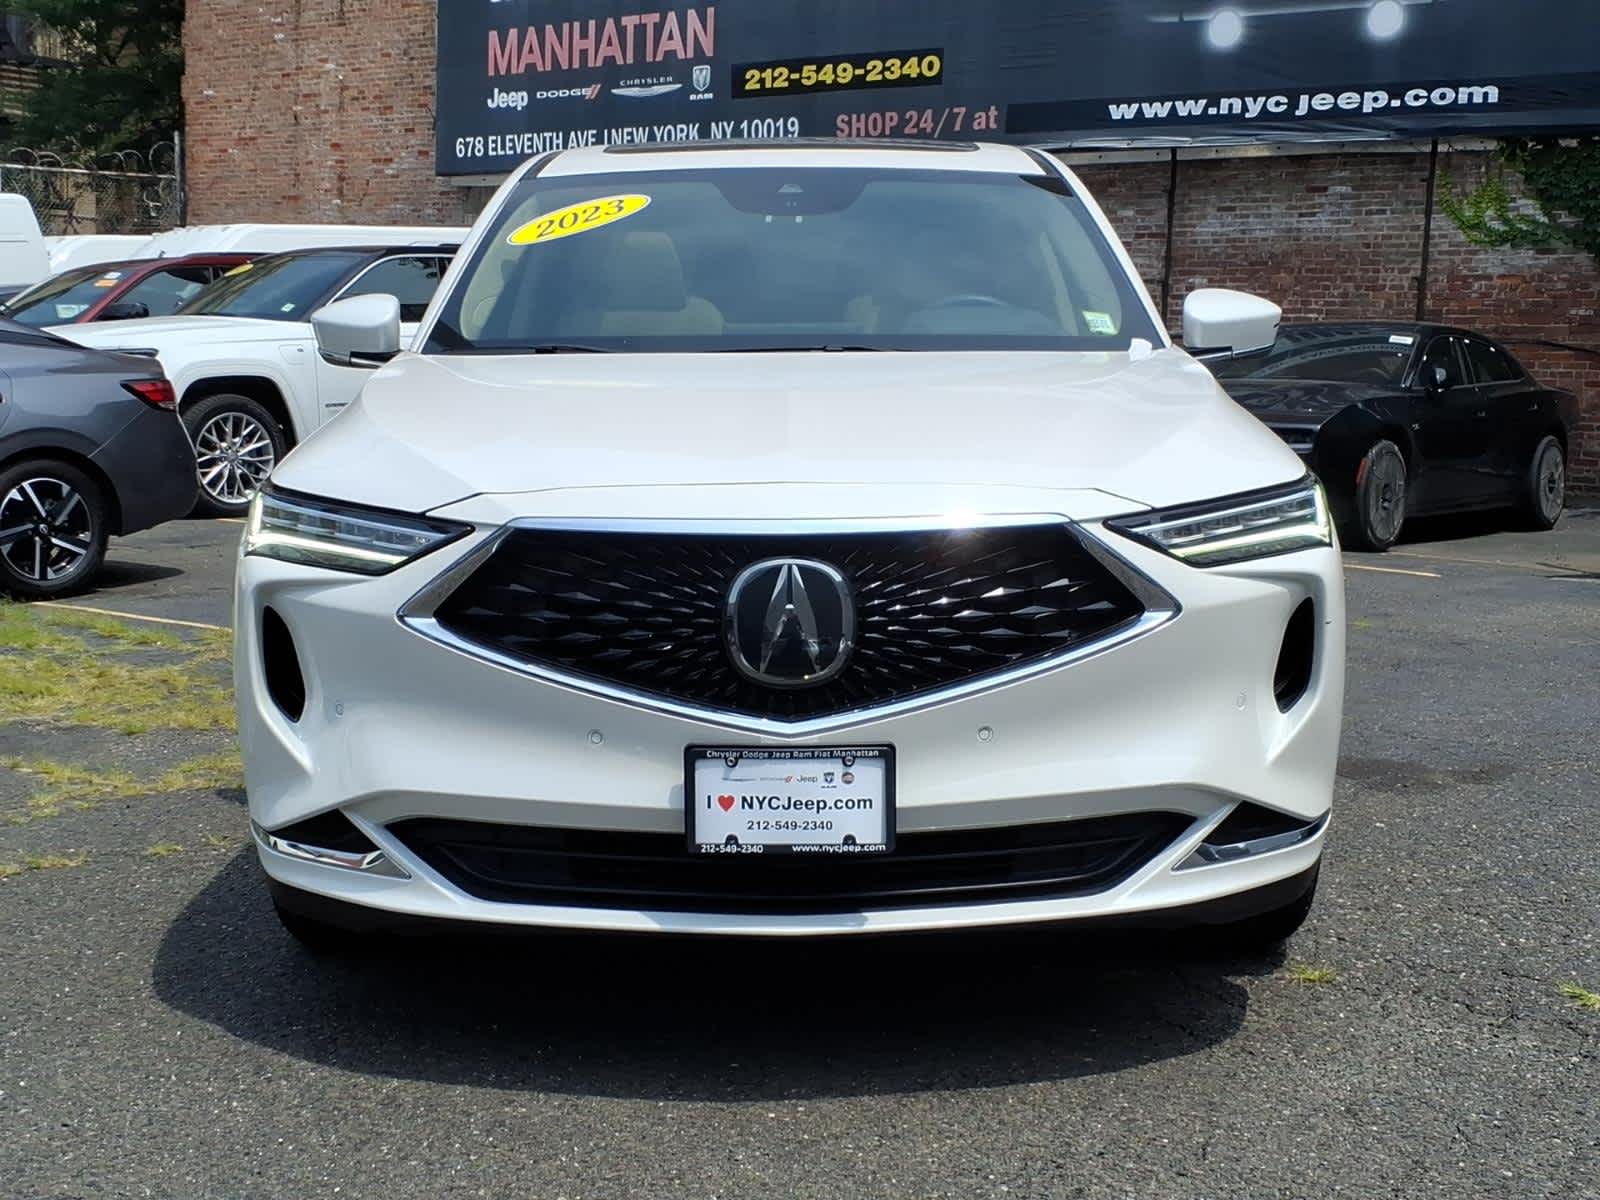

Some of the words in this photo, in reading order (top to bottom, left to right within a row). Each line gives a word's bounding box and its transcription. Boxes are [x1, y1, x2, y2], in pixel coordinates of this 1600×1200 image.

[487, 7, 715, 77] MANHATTAN
[619, 76, 673, 87] CHRYSLER
[743, 54, 942, 91] 212-549-2340
[487, 88, 529, 111] Jeep
[536, 89, 594, 100] DODGE
[835, 111, 898, 138] SHOP
[903, 106, 966, 139] 24/7
[972, 105, 998, 131] at
[455, 136, 484, 158] 678
[487, 131, 563, 156] ELEVENTH
[567, 129, 597, 150] AVE
[653, 122, 700, 142] YORK
[710, 121, 735, 140] NY
[739, 116, 800, 139] 10019
[536, 199, 625, 239] 2023
[706, 750, 741, 760] Chrysler
[742, 750, 770, 760] Dodge
[771, 750, 791, 759] Jeep
[814, 750, 831, 758] Fiat
[832, 750, 879, 758] Manhattan
[706, 795, 712, 809] I
[741, 796, 873, 814] NYCJeep.com
[747, 820, 833, 831] 212-549-2340
[700, 844, 764, 854] 212-549-2340
[792, 844, 886, 853] www.nycjeep.com
